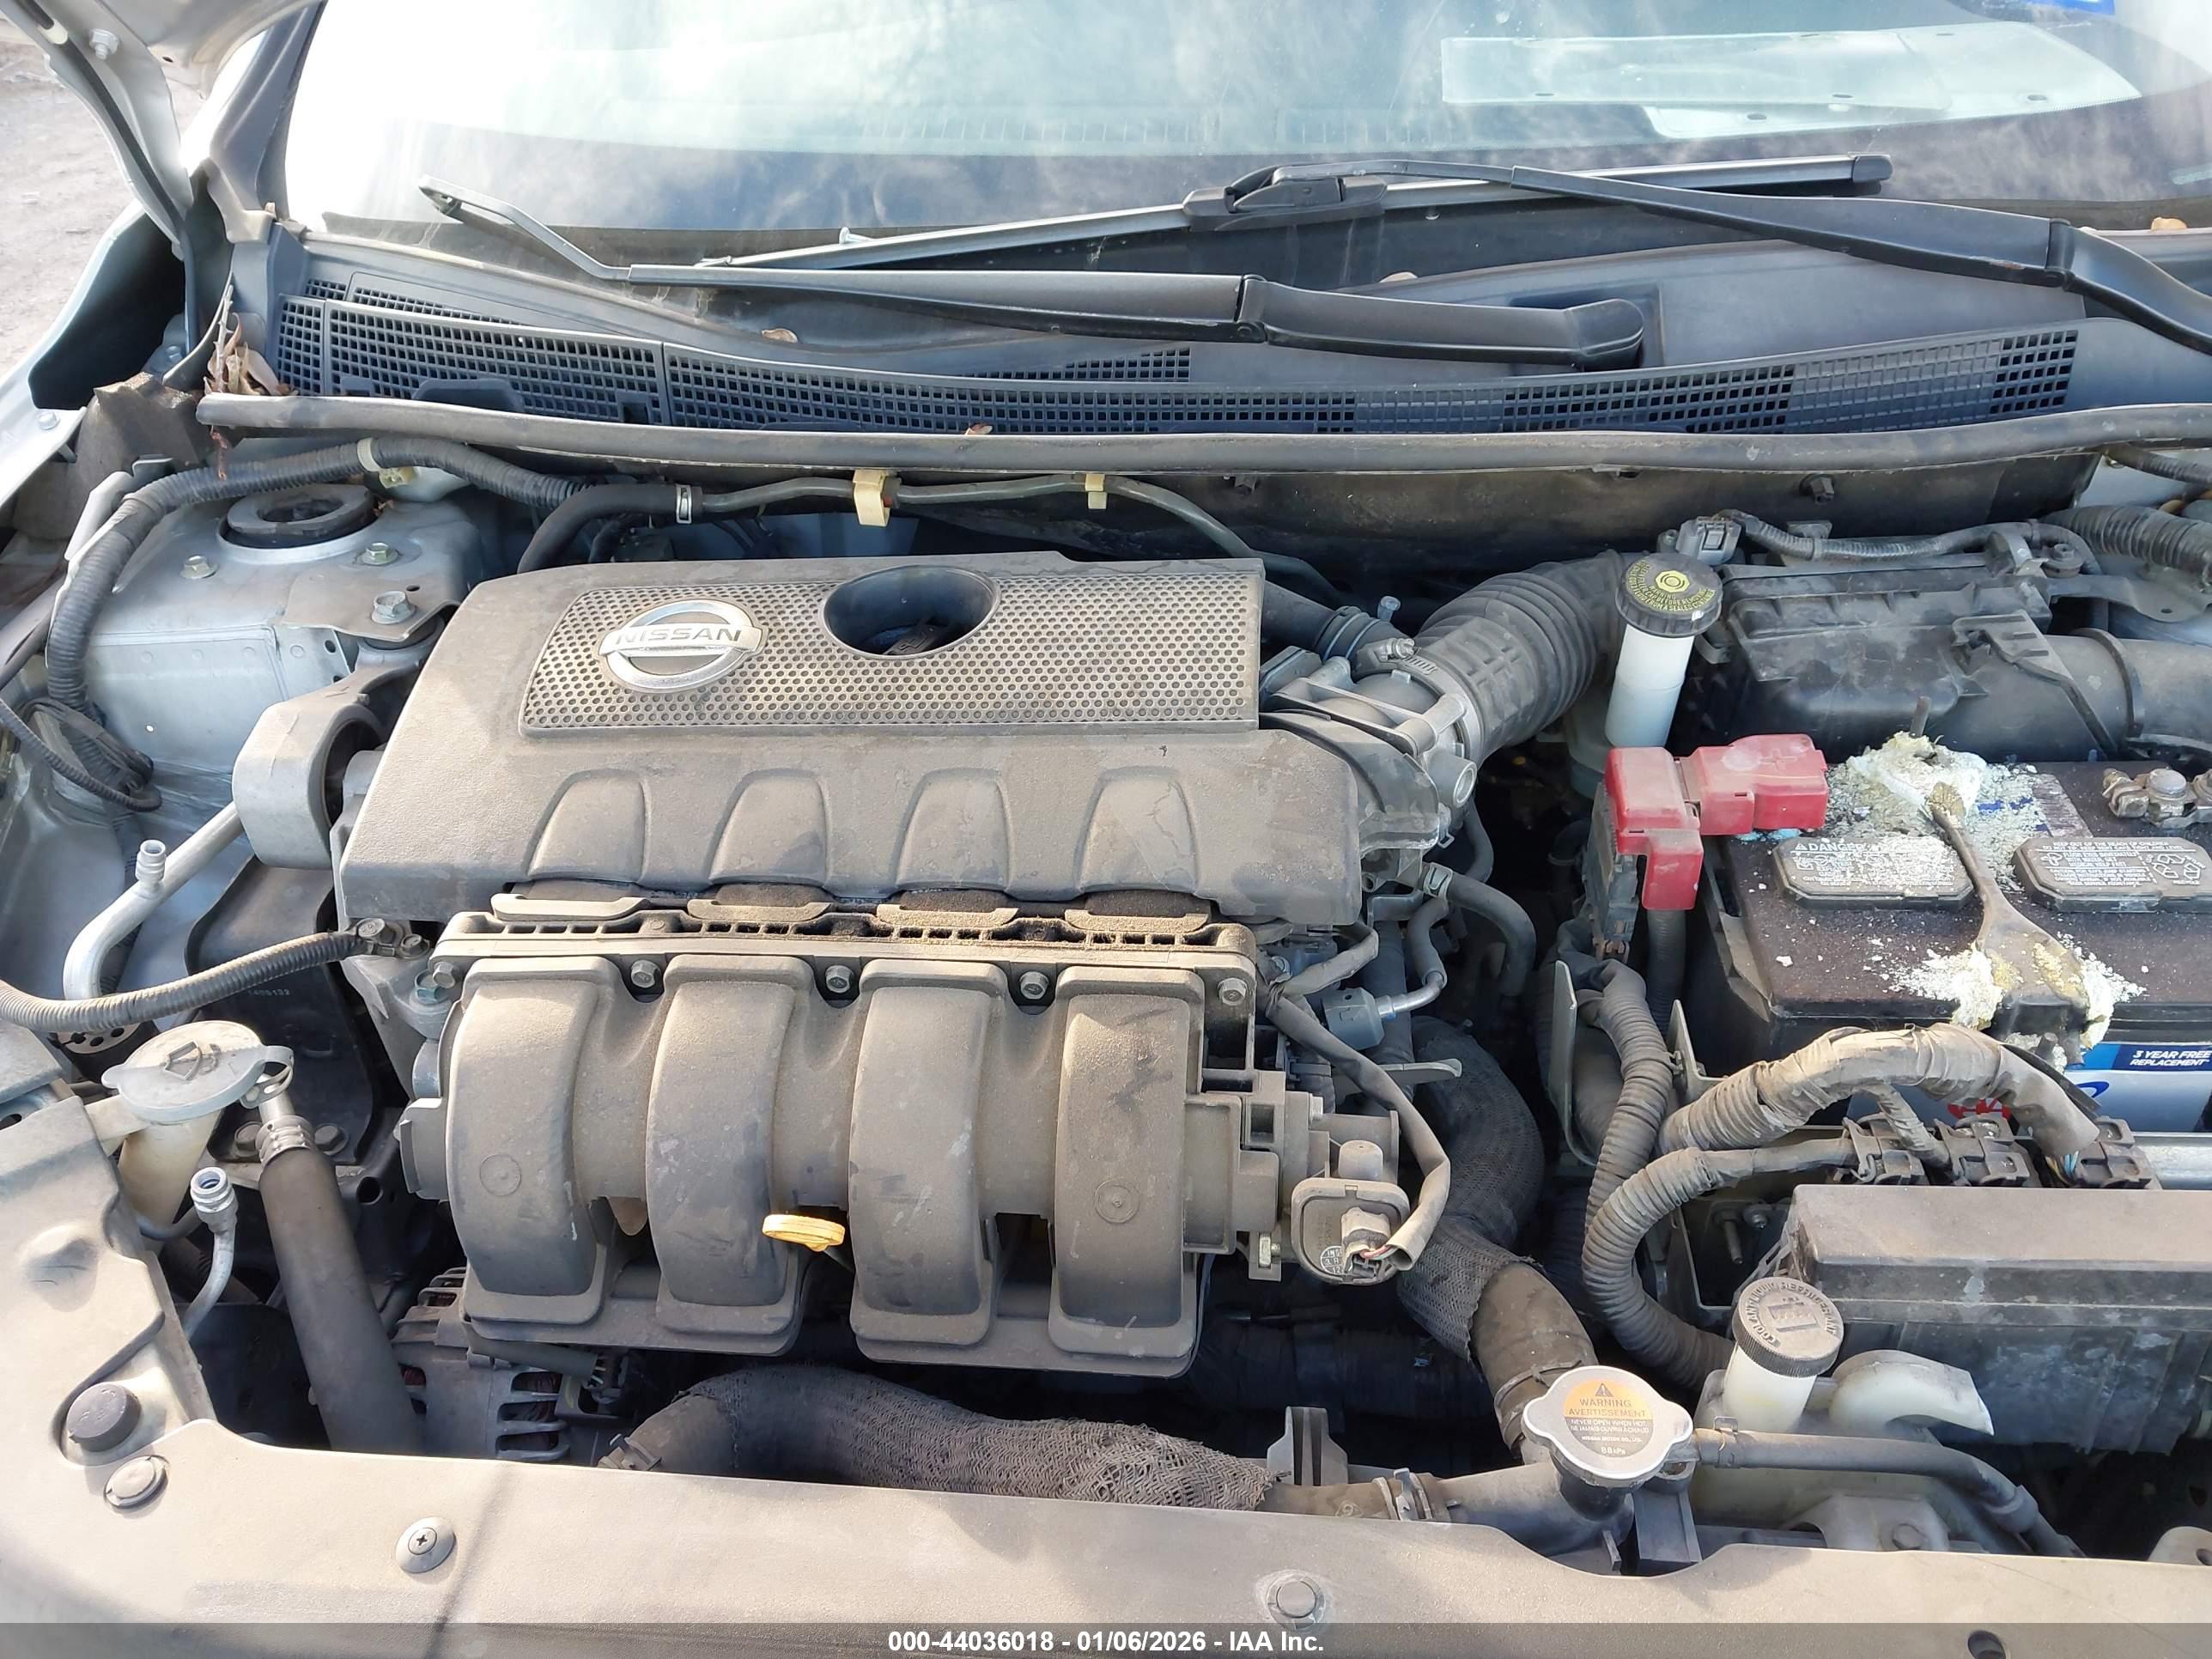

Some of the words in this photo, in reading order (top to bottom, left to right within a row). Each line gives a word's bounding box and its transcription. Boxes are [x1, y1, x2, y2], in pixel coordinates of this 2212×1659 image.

[616, 628, 742, 645] NISSAN
[2133, 1050, 2144, 1059] 3
[2145, 1050, 2179, 1059] YEAR
[2179, 1050, 2212, 1059] FREE
[1580, 1398, 1632, 1408] WARNING
[1569, 1408, 1646, 1418] AVERTISSEMENT
